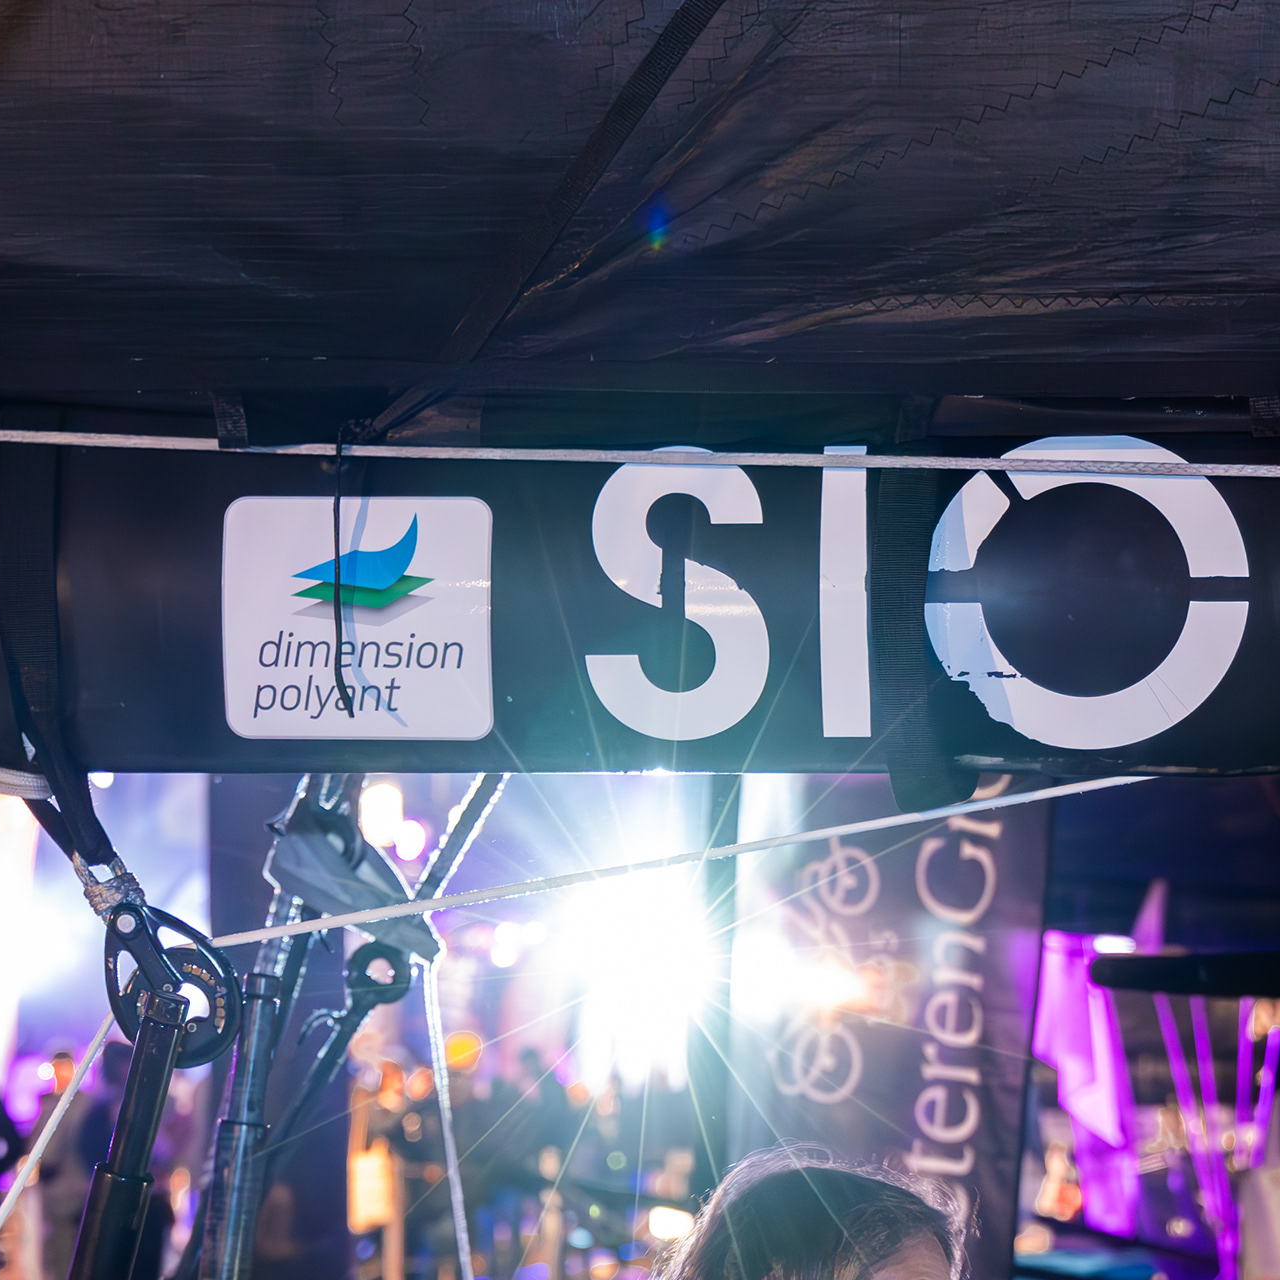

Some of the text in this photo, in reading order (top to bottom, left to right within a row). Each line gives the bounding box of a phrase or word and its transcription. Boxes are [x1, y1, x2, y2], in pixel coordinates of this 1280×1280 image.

[257, 630, 464, 669] dimension
[253, 674, 402, 720] polyant
[902, 774, 1013, 1232] terenGr
